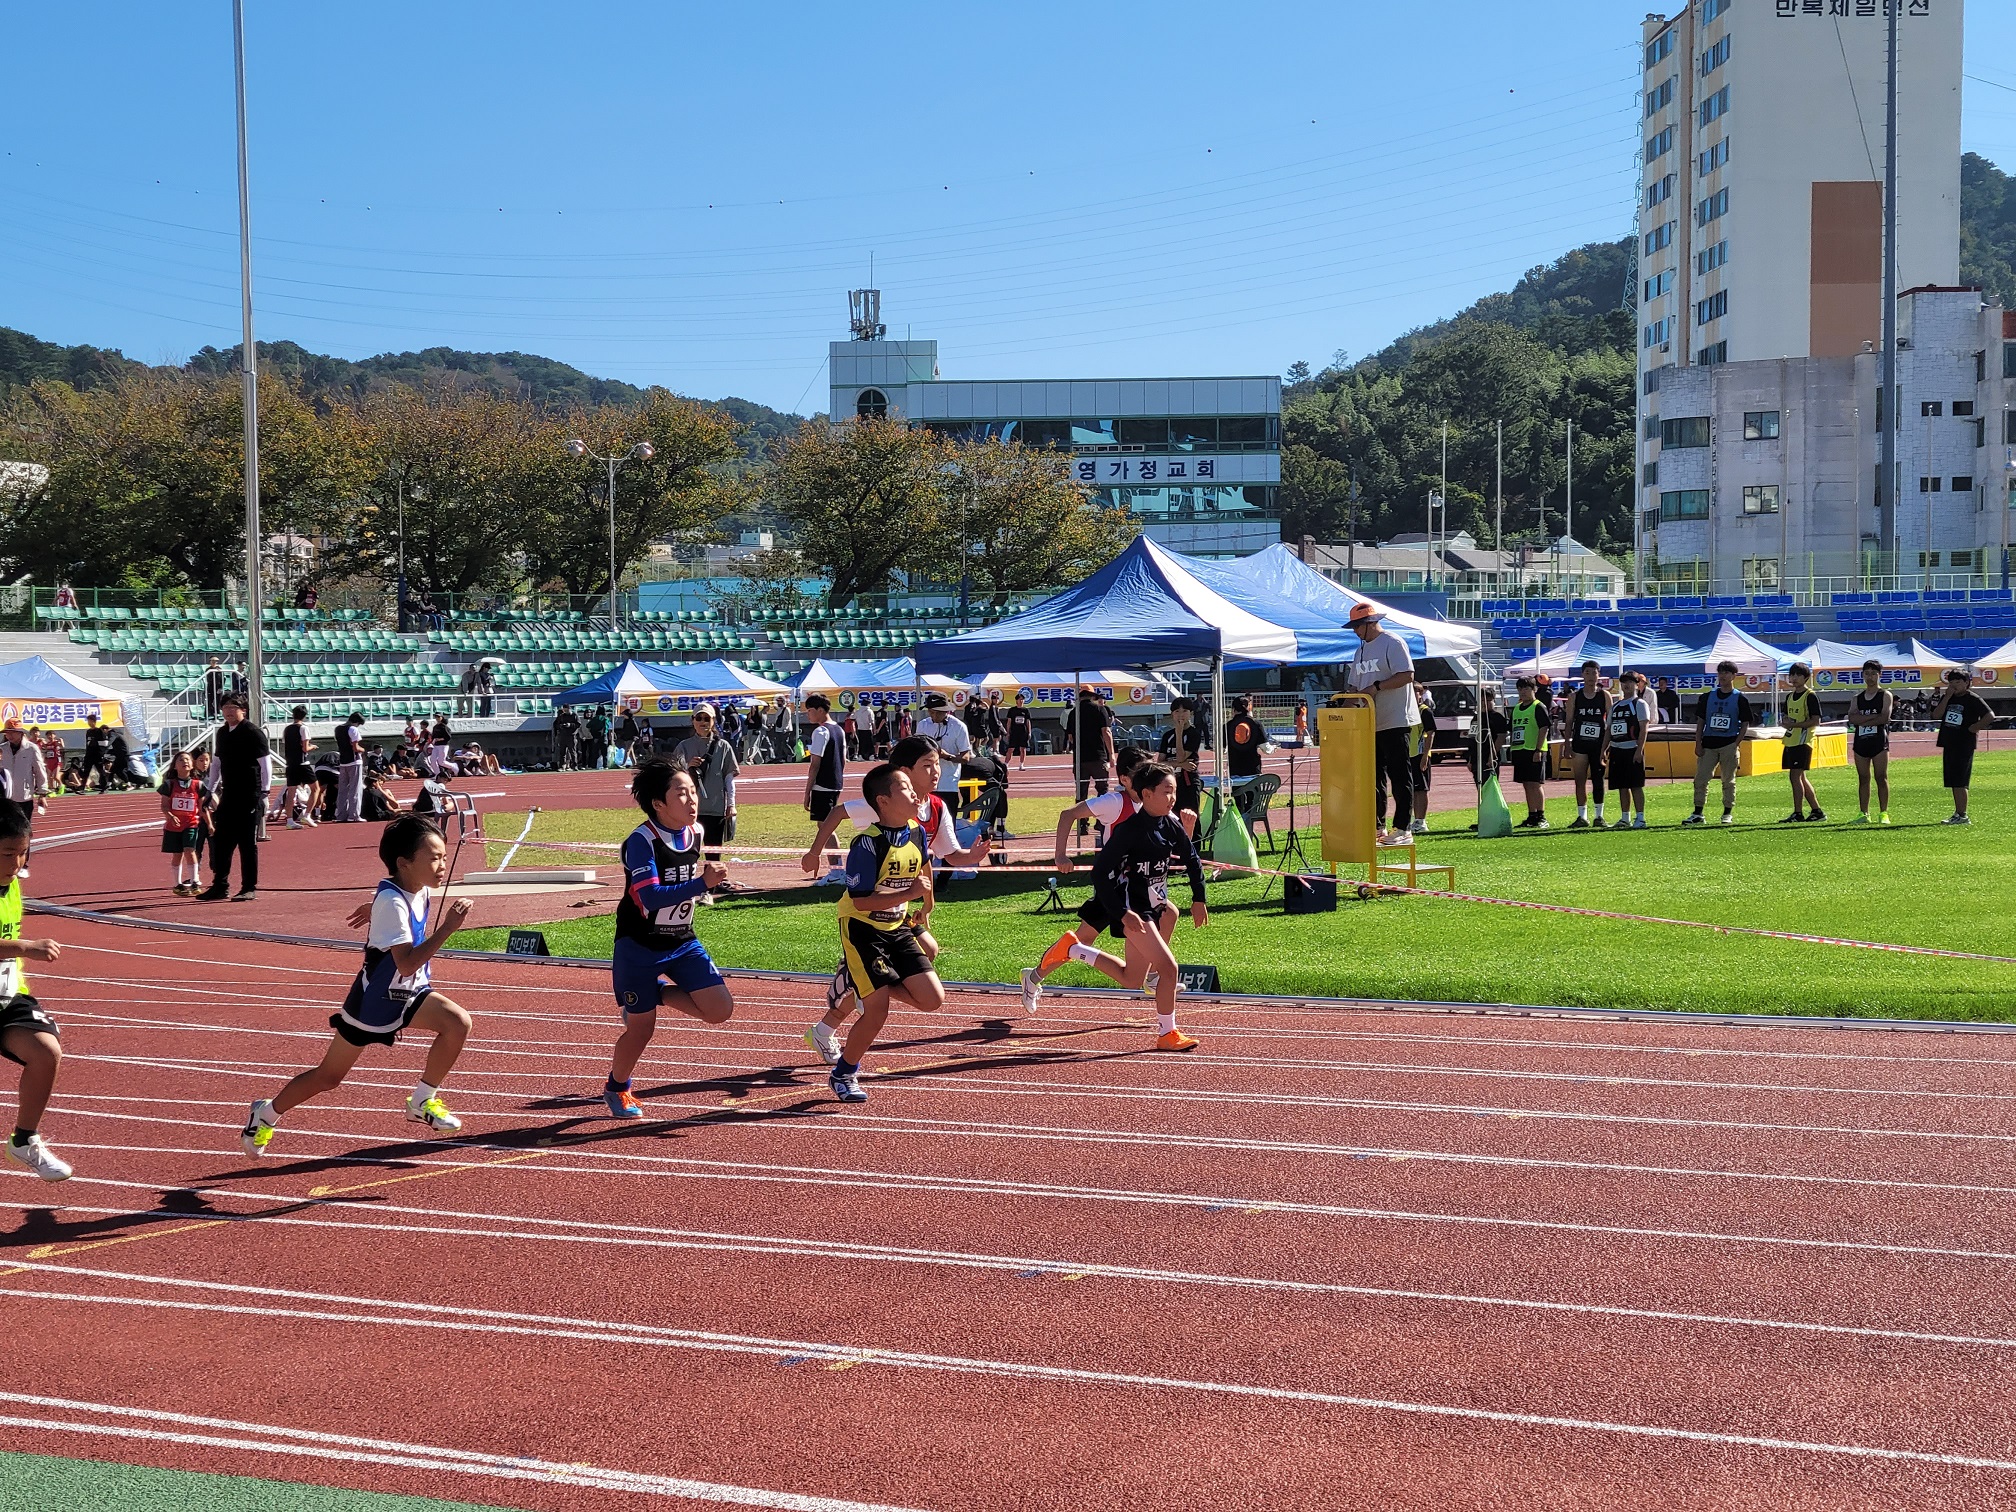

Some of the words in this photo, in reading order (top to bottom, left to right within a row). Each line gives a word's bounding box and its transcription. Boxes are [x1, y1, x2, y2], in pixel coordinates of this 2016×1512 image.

[1062, 460, 1215, 480] 영가정교회
[1837, 670, 1921, 684] 죽림등학교
[1037, 688, 1113, 702] 두룡초교
[22, 704, 101, 723] 산양초등학교
[1947, 713, 1959, 723] 52
[1713, 718, 1729, 727] 129
[1585, 726, 1596, 736] 68
[1613, 724, 1623, 734] 92
[177, 799, 190, 810] 31
[1179, 972, 1207, 992] 보호
